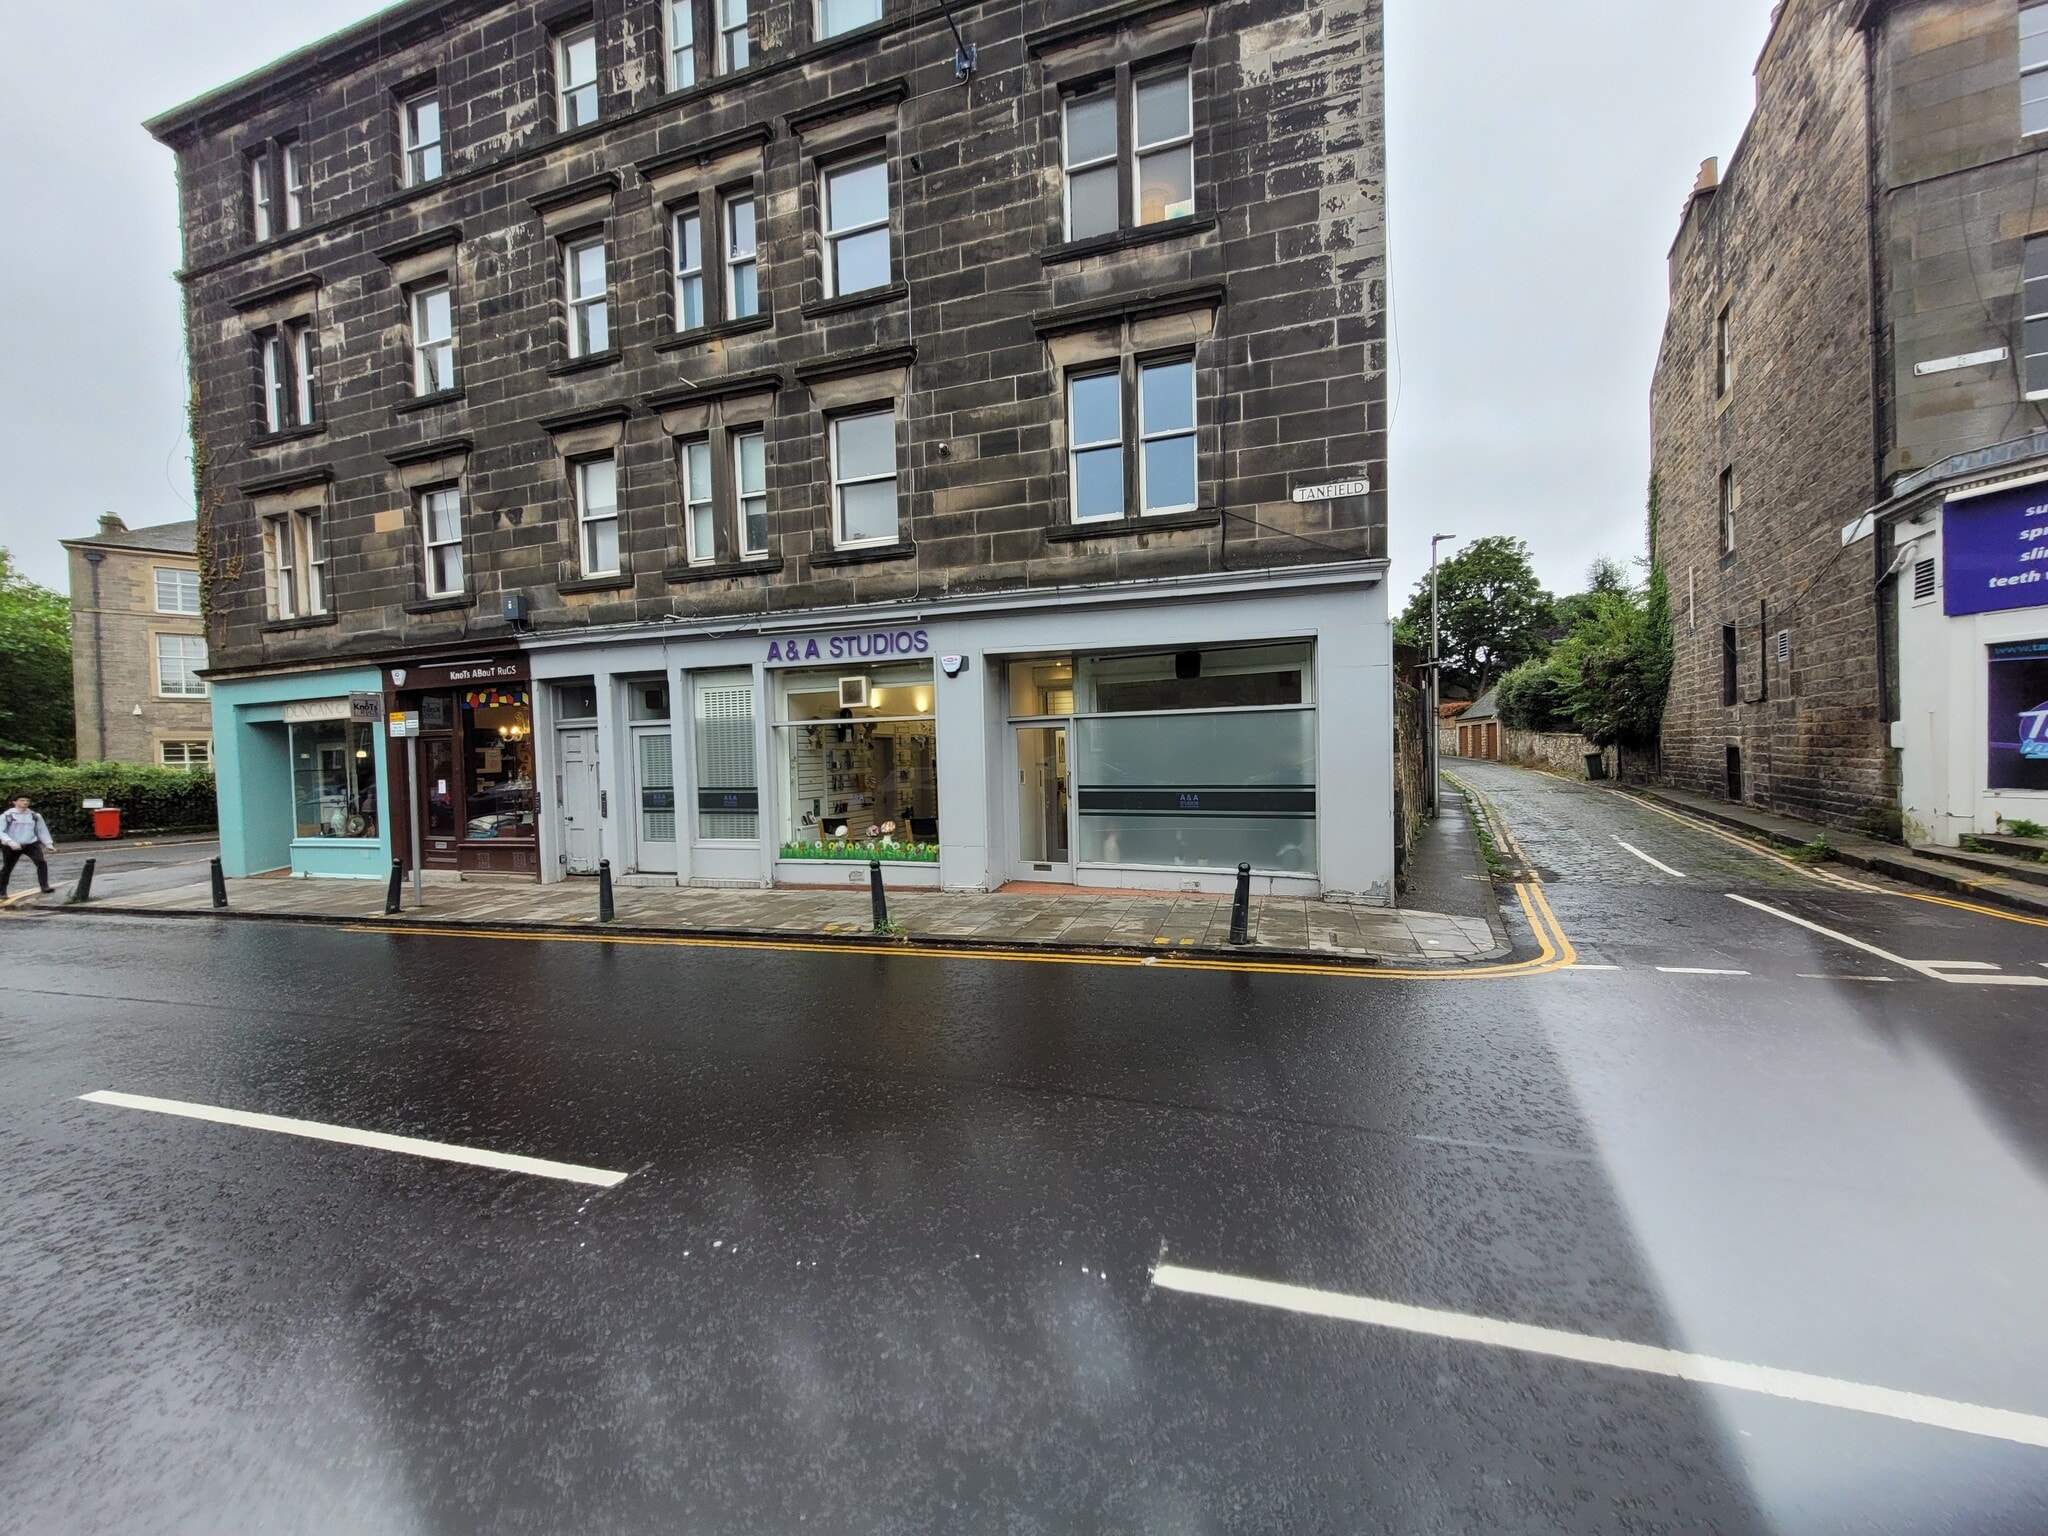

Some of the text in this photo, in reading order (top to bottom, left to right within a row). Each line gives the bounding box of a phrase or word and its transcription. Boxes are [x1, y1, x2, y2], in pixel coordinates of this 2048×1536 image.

[1299, 482, 1364, 500] TANFIELD
[1989, 570, 2041, 588] teeth
[829, 630, 929, 658] STUDIOS
[286, 703, 333, 719] DUNCAN
[584, 699, 589, 707] 7
[589, 764, 595, 772] 7
